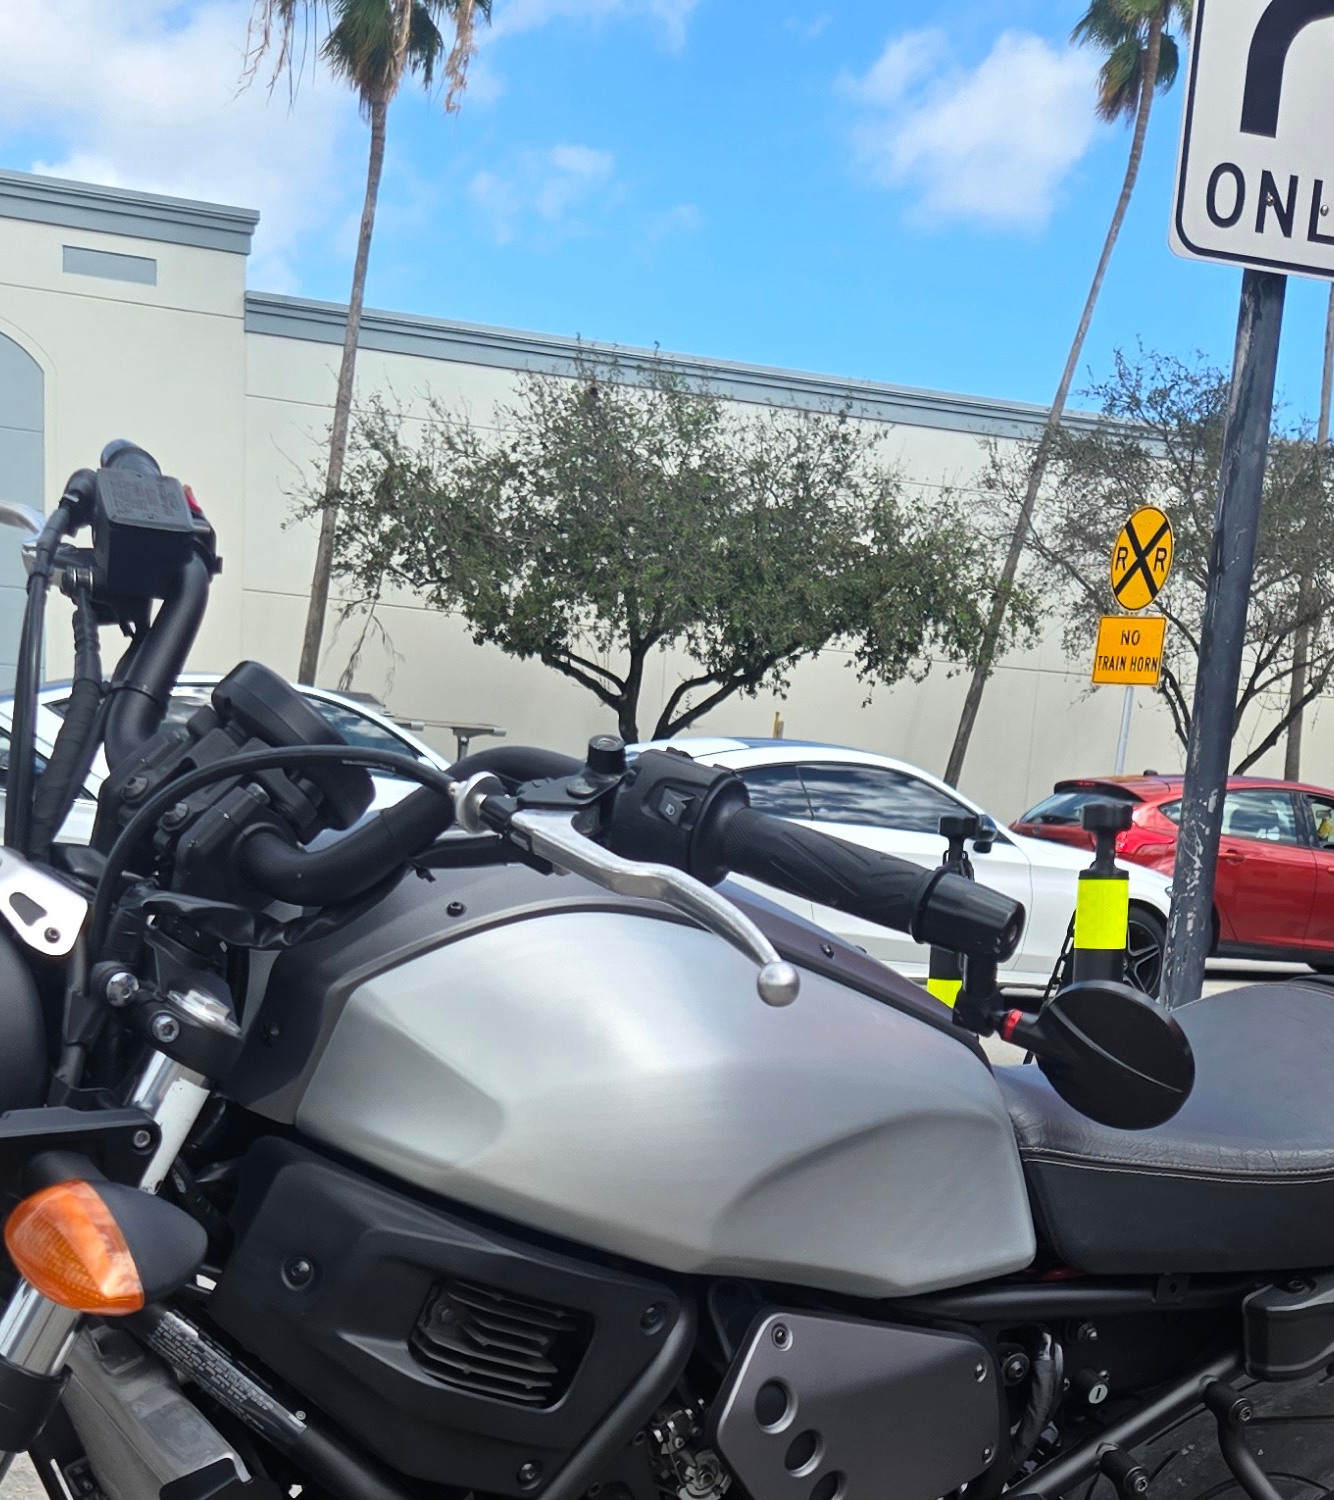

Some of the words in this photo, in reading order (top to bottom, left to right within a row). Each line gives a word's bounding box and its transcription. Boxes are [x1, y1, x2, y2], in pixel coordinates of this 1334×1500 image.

[1121, 630, 1141, 646] NO
[1098, 656, 1127, 671] TRAIN
[1130, 656, 1159, 672] HORN
